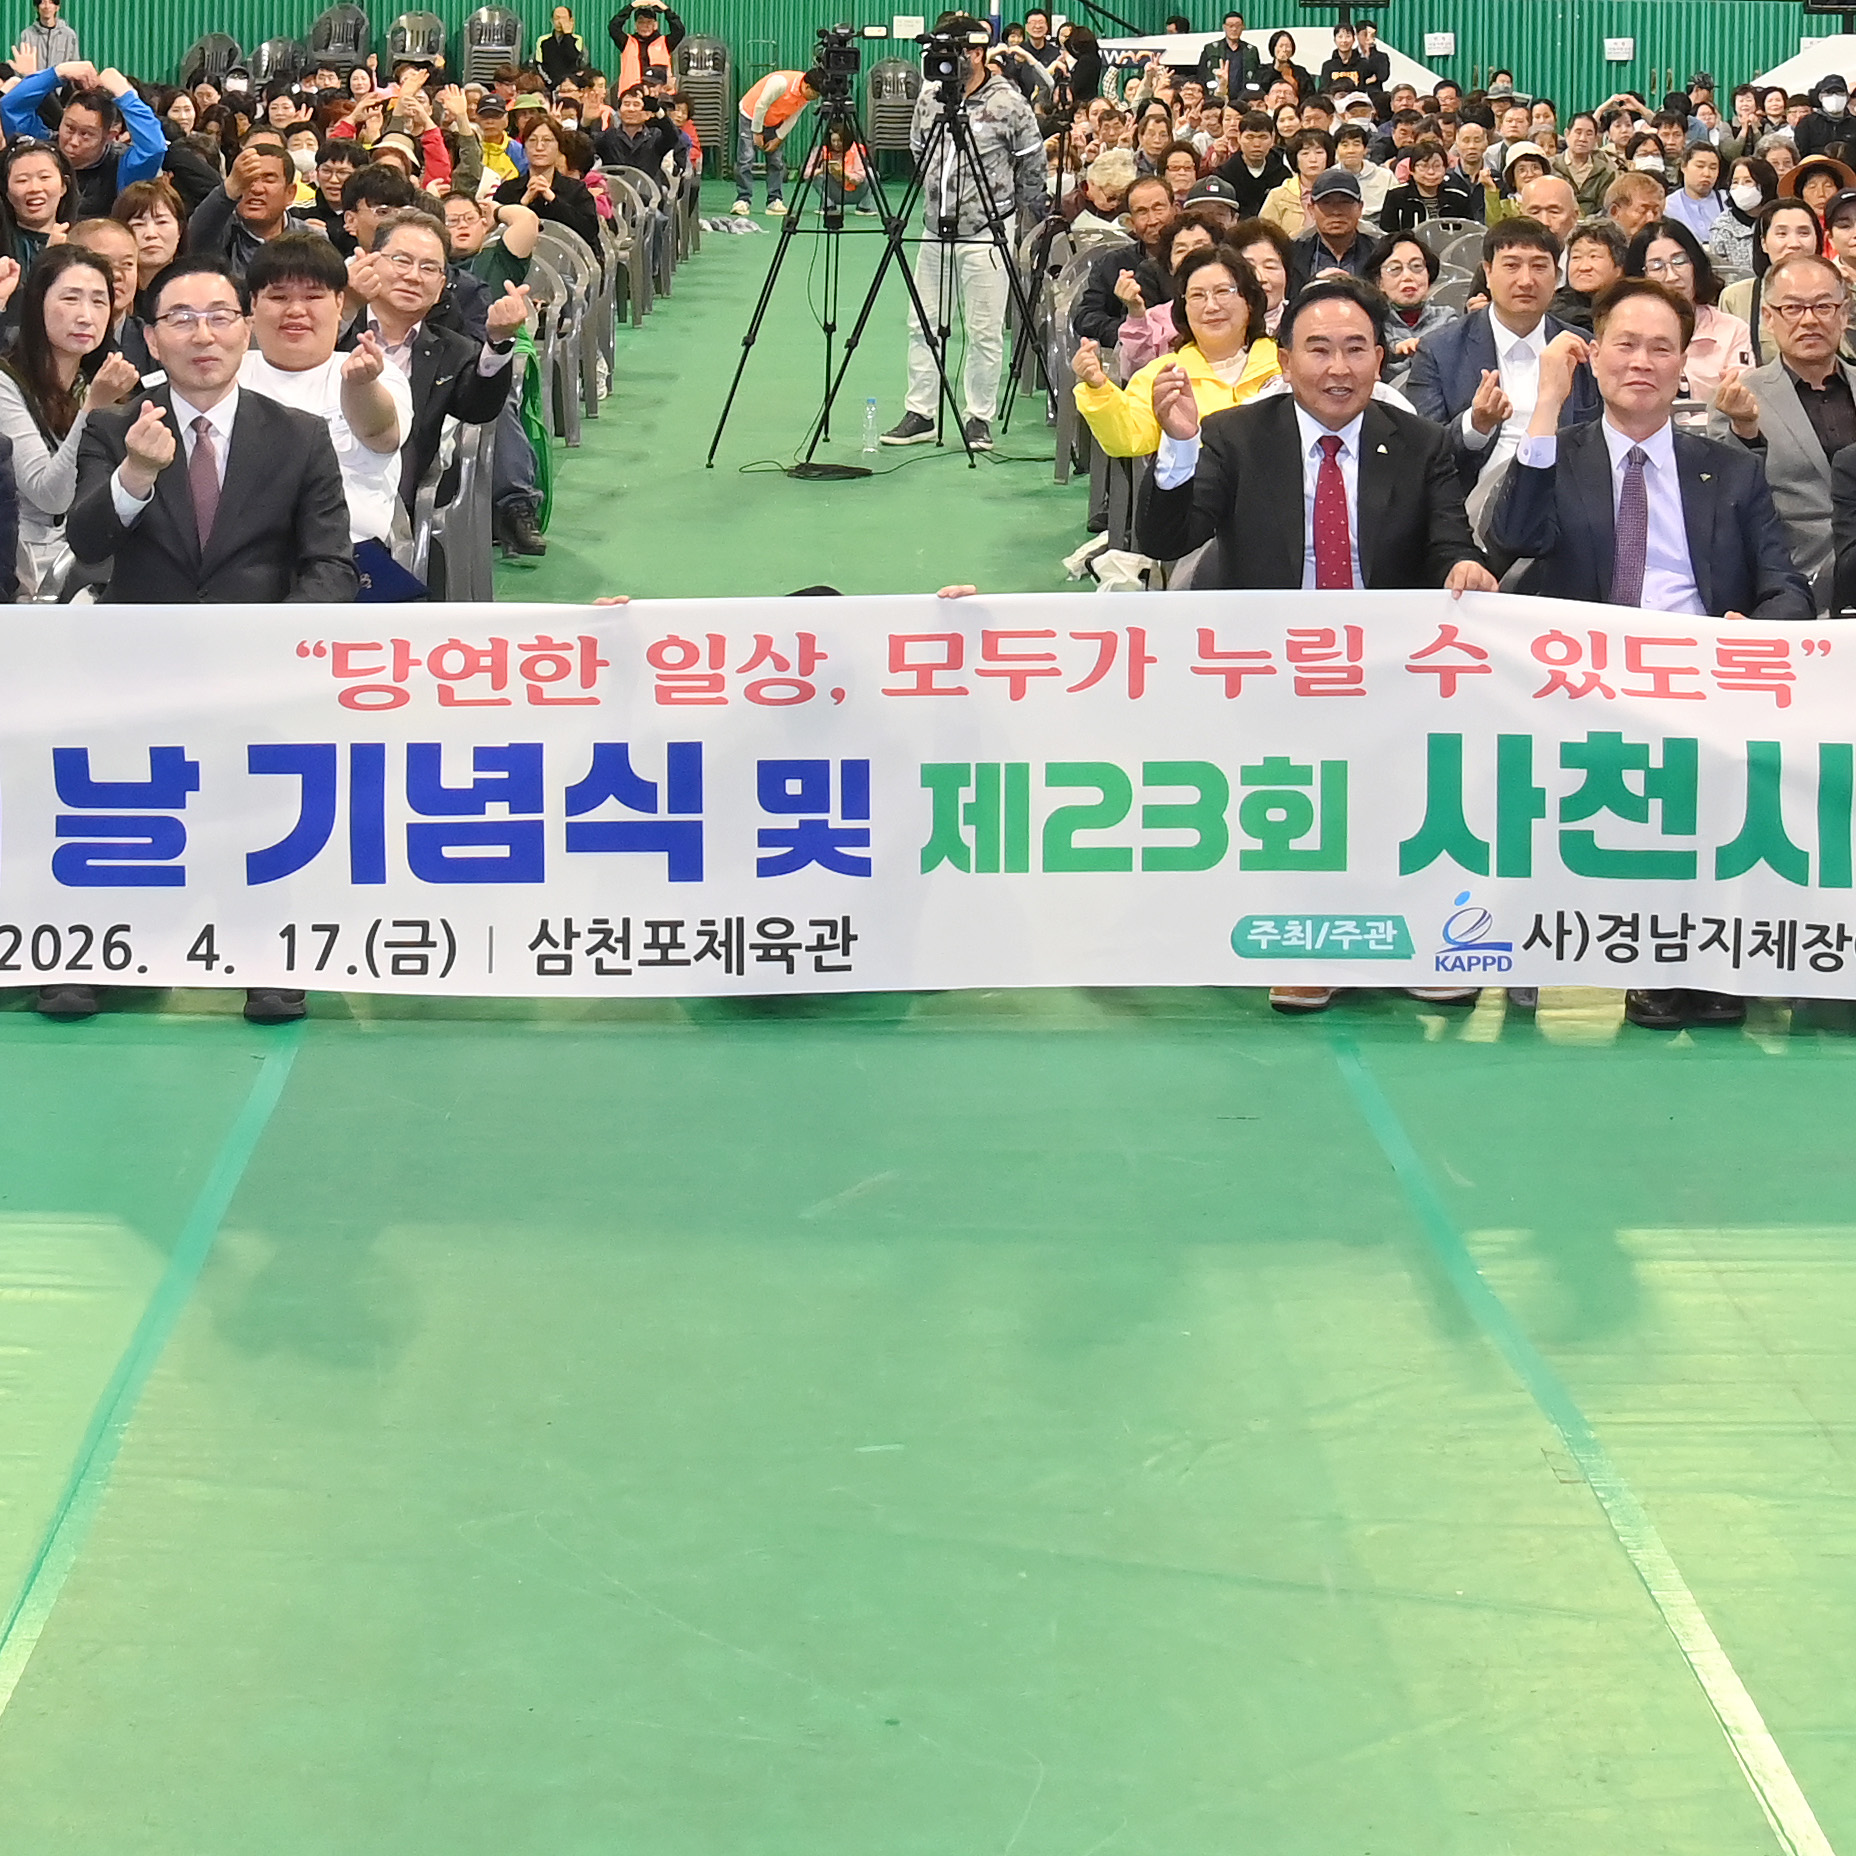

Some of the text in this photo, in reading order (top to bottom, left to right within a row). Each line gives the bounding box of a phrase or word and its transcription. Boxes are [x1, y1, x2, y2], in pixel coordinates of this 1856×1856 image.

[296, 624, 1832, 712] “당연한 일상, 모두가 누릴 수 있도록”
[51, 745, 200, 888] 날
[245, 741, 704, 887] 기념식
[756, 758, 872, 878] 및
[920, 756, 1349, 875] 제23회
[187, 924, 235, 974] 4.
[278, 918, 457, 979] 17.(금)
[528, 914, 858, 977] 삼천포체육관
[1246, 919, 1398, 955] 주최/주관
[1434, 955, 1512, 974] KAPPD
